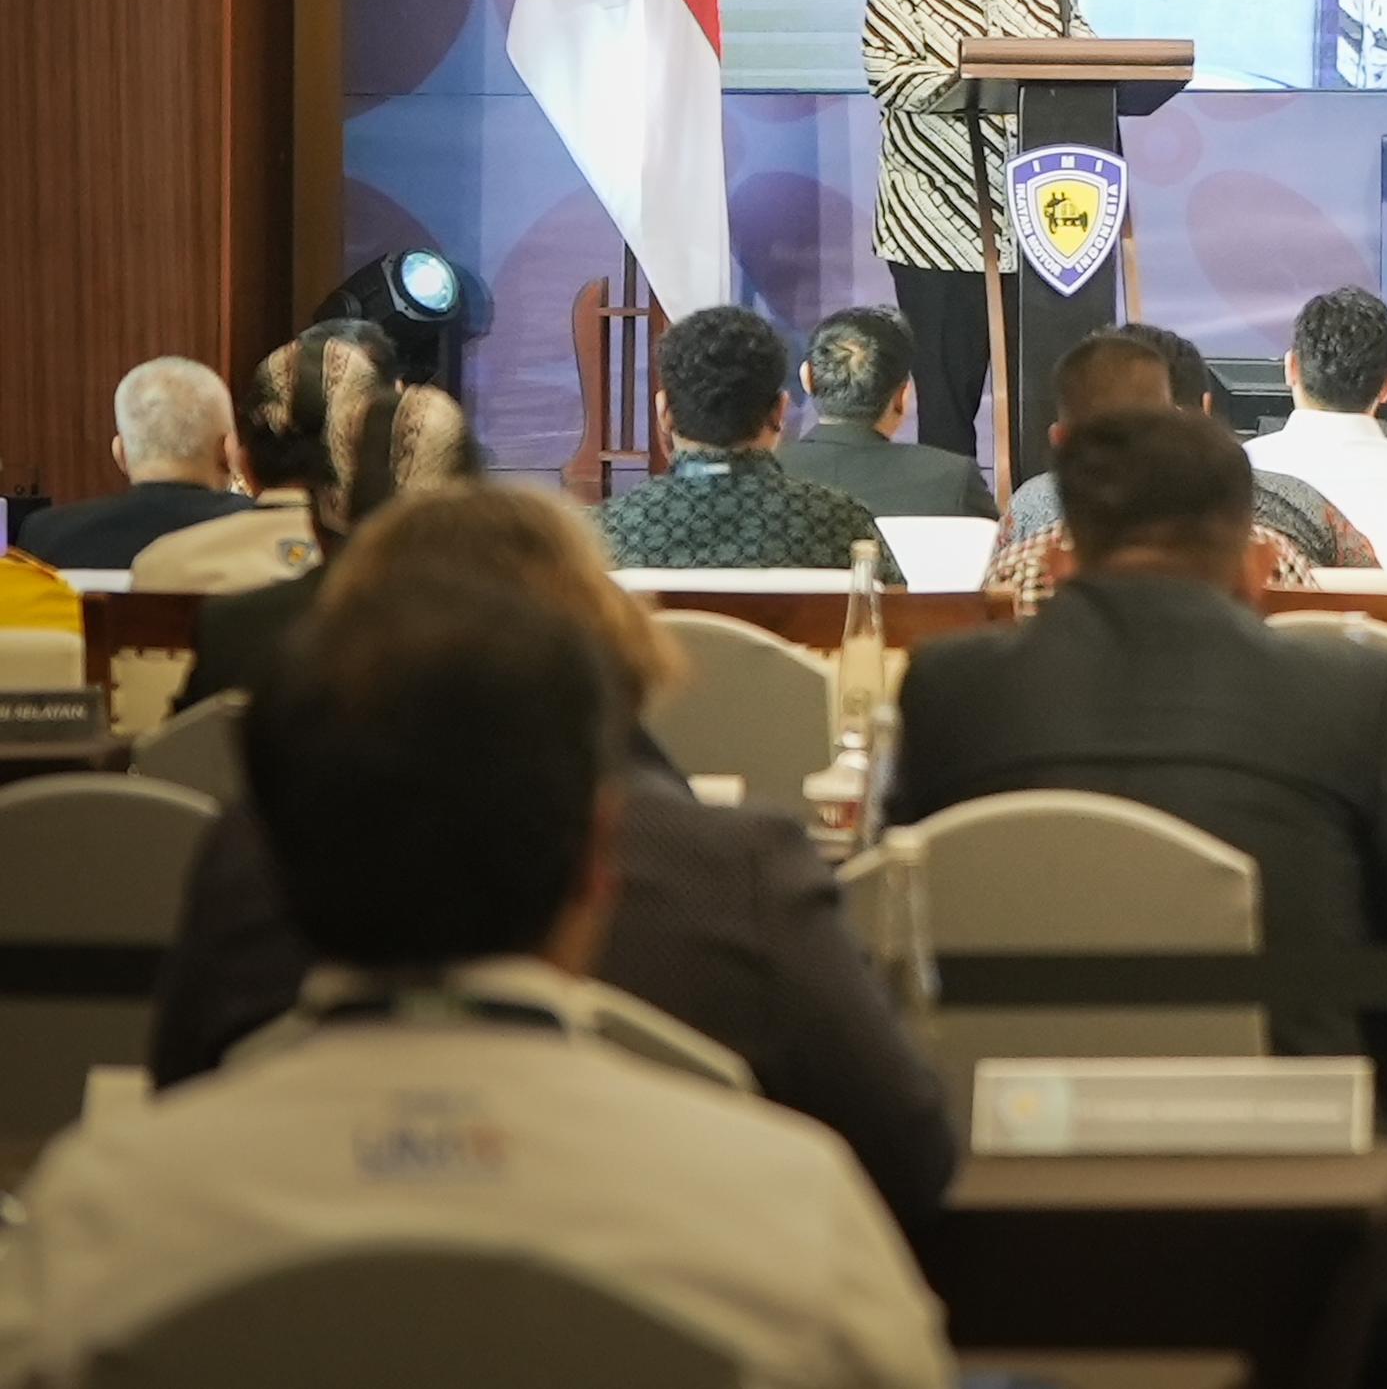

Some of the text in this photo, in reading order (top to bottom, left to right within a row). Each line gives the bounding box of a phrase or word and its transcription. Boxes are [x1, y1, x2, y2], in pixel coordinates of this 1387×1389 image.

[1015, 182, 1033, 236] IKATAN
[1073, 183, 1119, 274] INDONESIA
[1026, 234, 1063, 277] MOTOR
